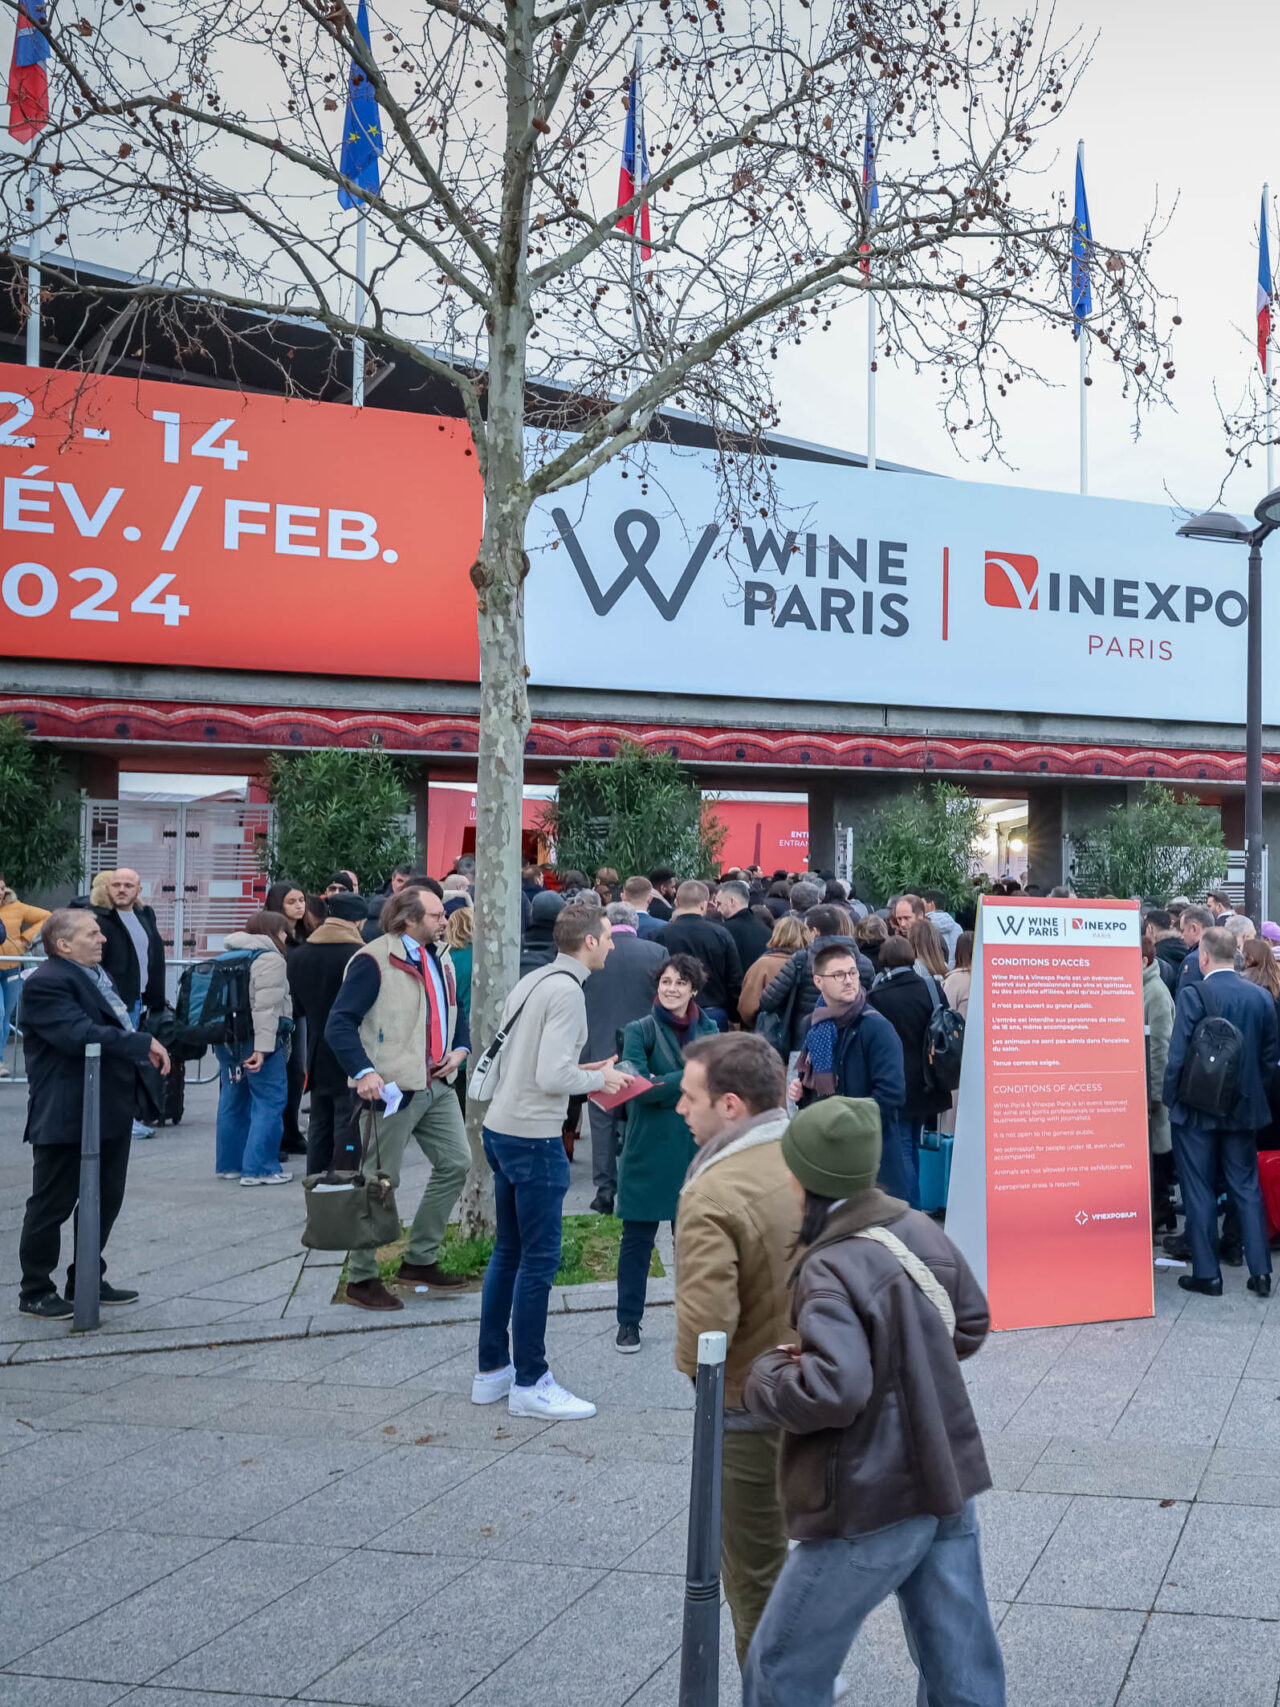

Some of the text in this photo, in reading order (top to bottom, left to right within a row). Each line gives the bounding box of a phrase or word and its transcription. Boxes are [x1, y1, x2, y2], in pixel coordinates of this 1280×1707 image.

[152, 409, 248, 471] 14
[2, 465, 141, 543] ÉV.
[224, 498, 399, 564] FEB.
[743, 526, 907, 586] WINE
[1, 562, 190, 626] 024
[985, 550, 1248, 627] VINEXPO
[744, 581, 910, 638] PARIS
[1089, 635, 1173, 661] PARIS
[1028, 917, 1058, 927] WINE
[1028, 927, 1059, 937] PARIS
[1072, 918, 1127, 931] VINEXPO
[991, 958, 1049, 966] CONDITIONS
[993, 1083, 1103, 1094] CONDITIONS OF ACCESS
